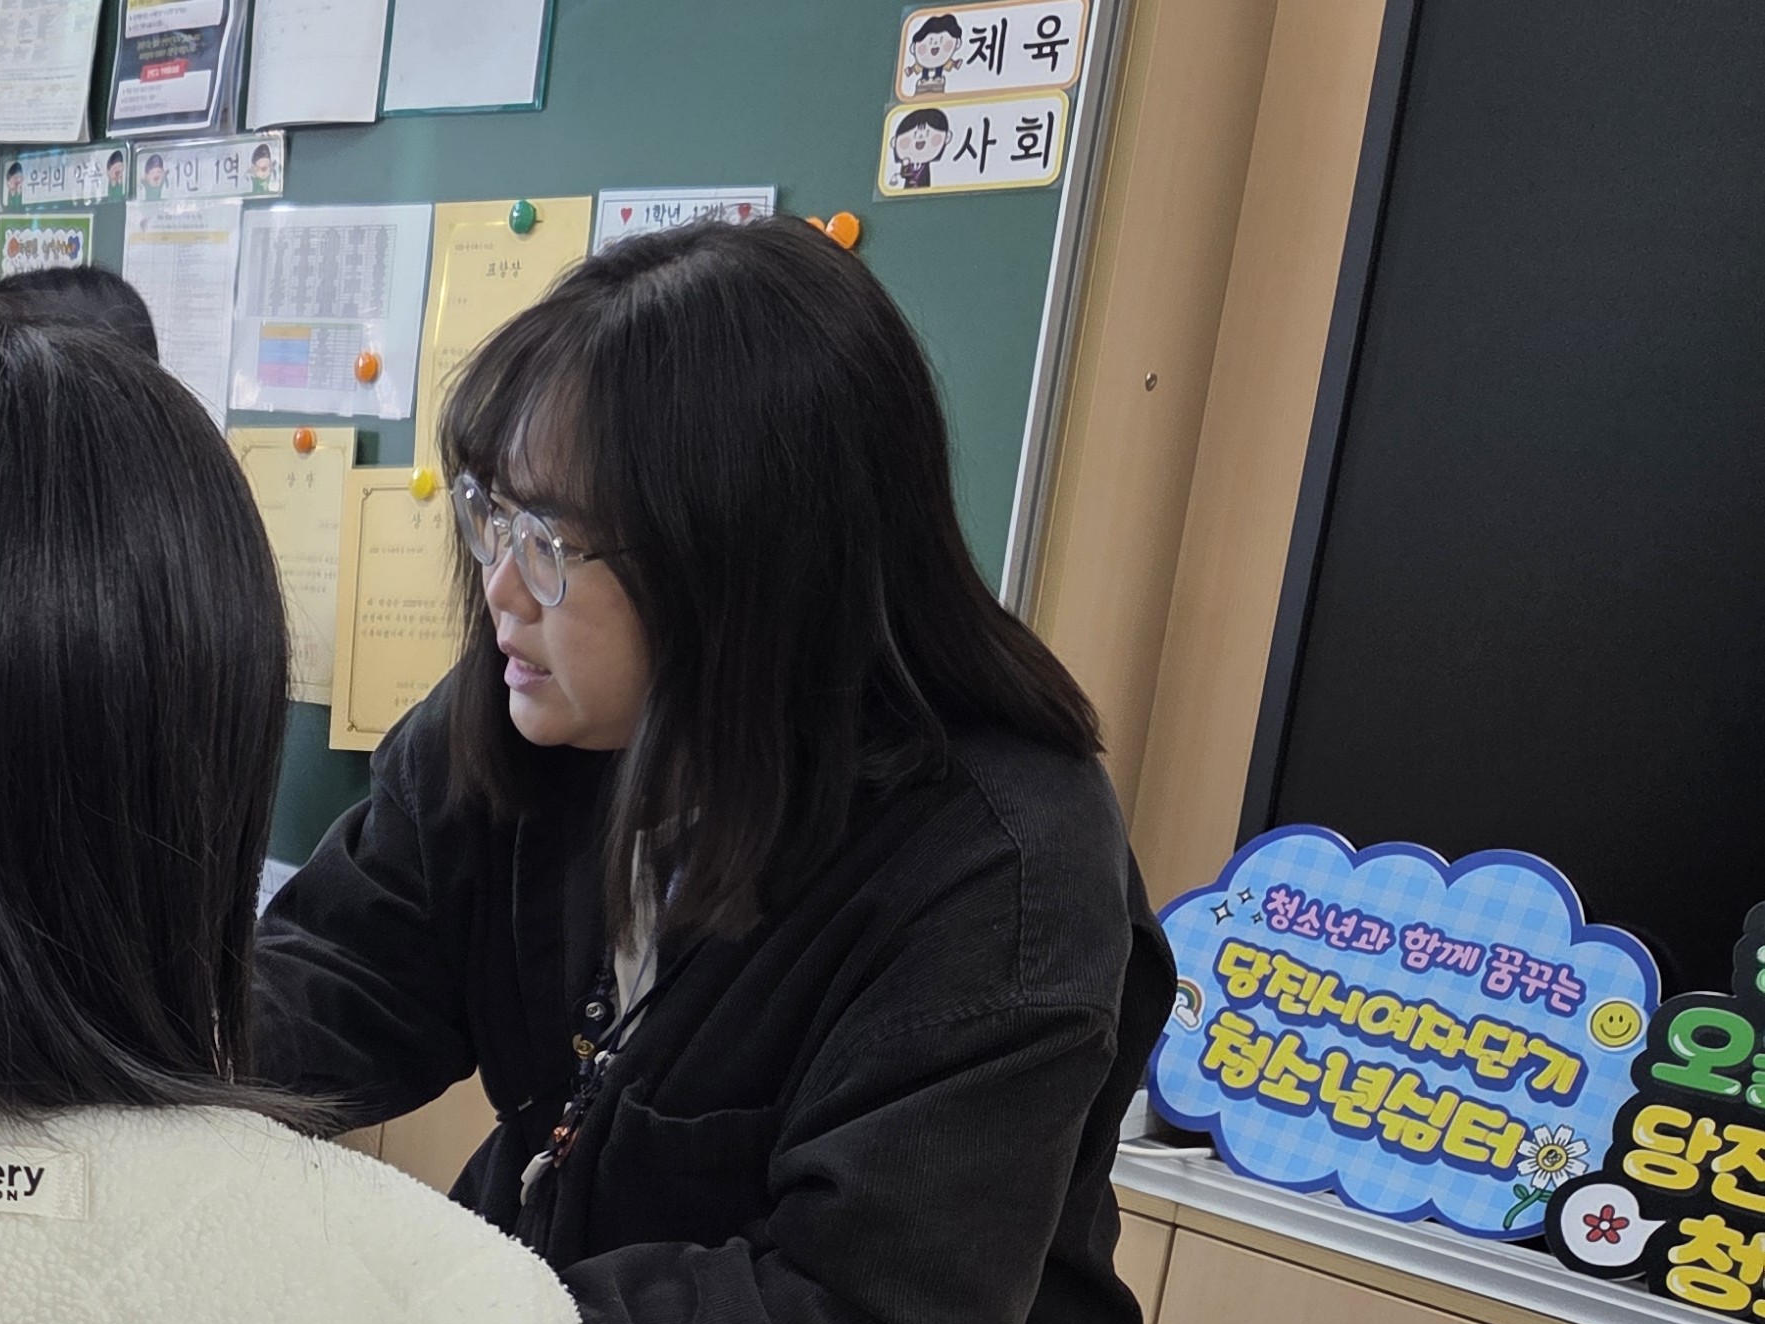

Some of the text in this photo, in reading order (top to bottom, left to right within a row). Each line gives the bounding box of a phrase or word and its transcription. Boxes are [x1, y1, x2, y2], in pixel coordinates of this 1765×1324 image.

[27, 166, 65, 195] 우리의
[174, 152, 239, 191] 1인 1역
[1266, 886, 1583, 1014] 청소년과 함께 꿈꾸는
[1215, 940, 1583, 1096] 당진시여자단기
[1651, 1006, 1765, 1107] 오
[1202, 1011, 1527, 1170] 청소년쉼터
[1666, 1214, 1765, 1318] 청
